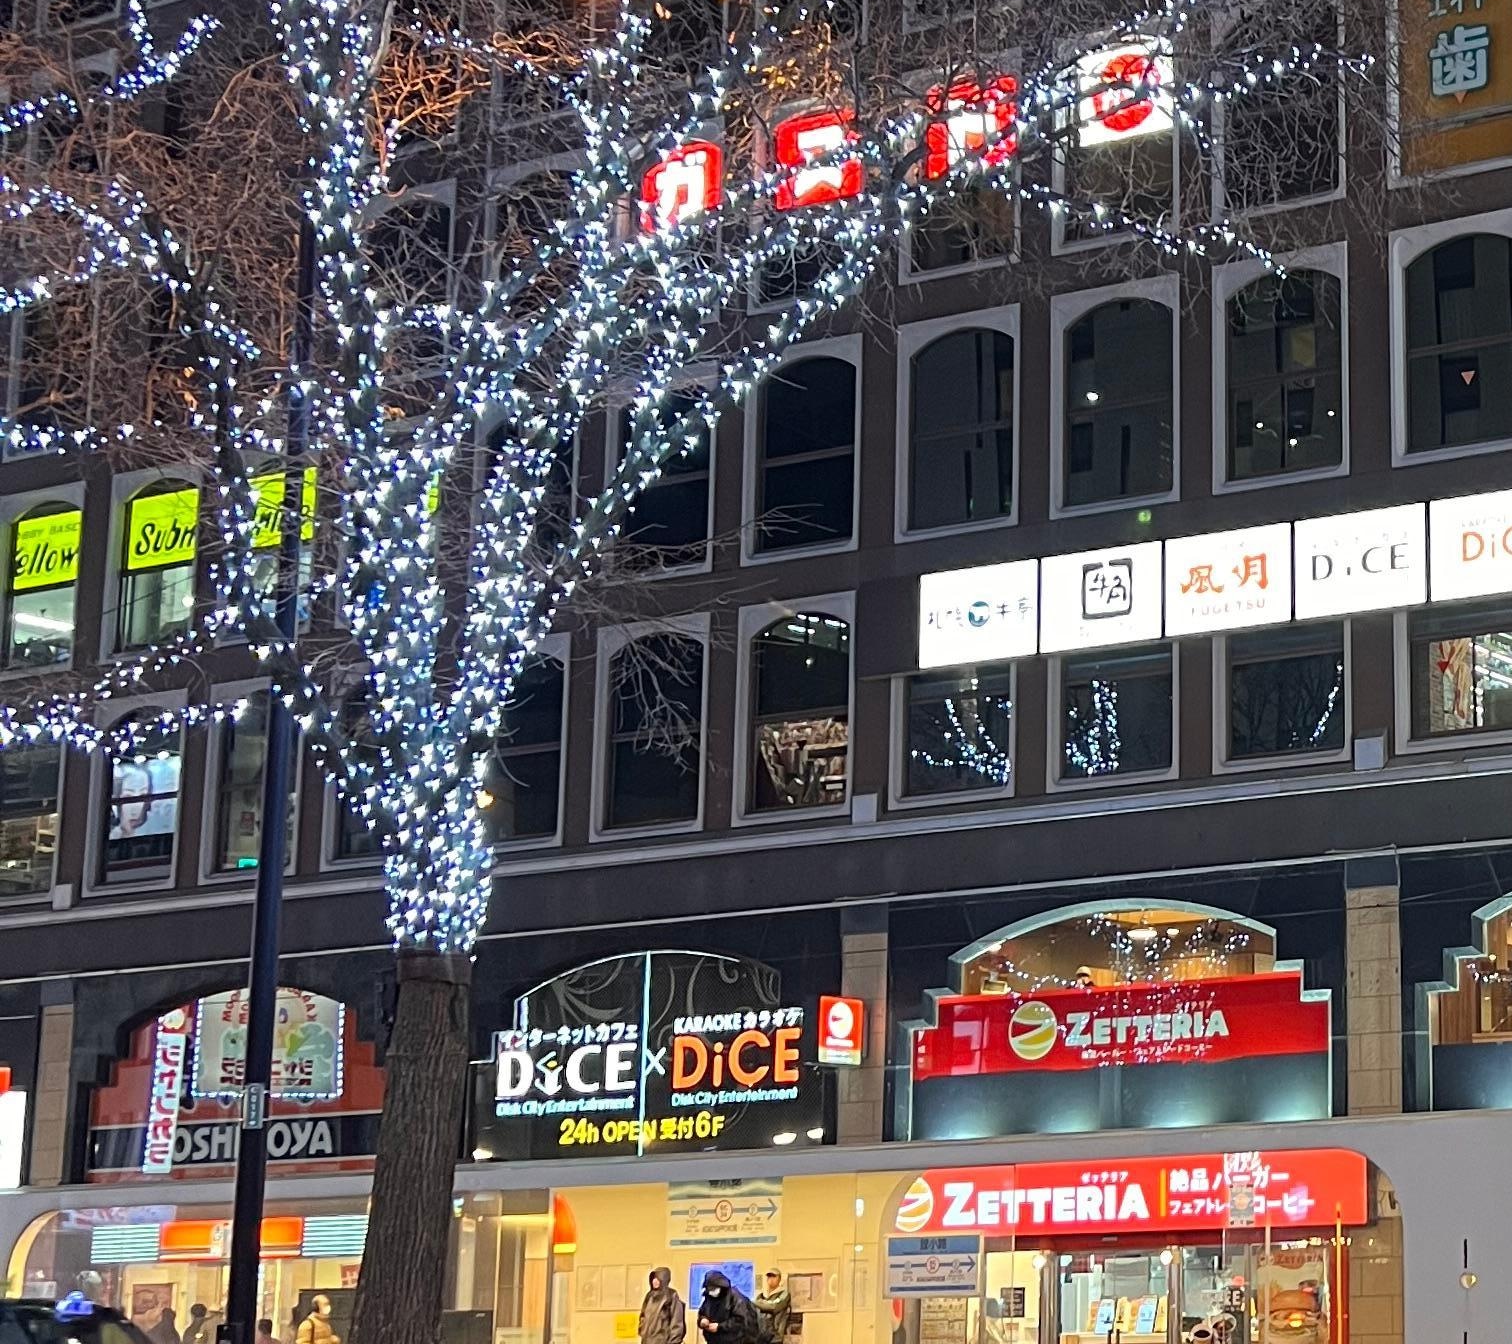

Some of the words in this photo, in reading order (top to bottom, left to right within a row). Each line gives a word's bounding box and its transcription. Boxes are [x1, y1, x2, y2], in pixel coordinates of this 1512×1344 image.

[15, 541, 79, 577] ellow
[499, 1022, 639, 1049] インターネットカフェ
[673, 1011, 743, 1035] KARAOKE
[743, 1007, 804, 1027] カラオケ
[1064, 1010, 1230, 1048] ZETTERIA
[670, 1027, 801, 1091] DiCE
[172, 1120, 335, 1163] OSHIOYA
[558, 1117, 600, 1146] 24h
[601, 1116, 658, 1143] OPEN
[942, 1181, 1151, 1227] ZETTERIA
[1169, 1192, 1316, 1217] フェアトレコーヒー
